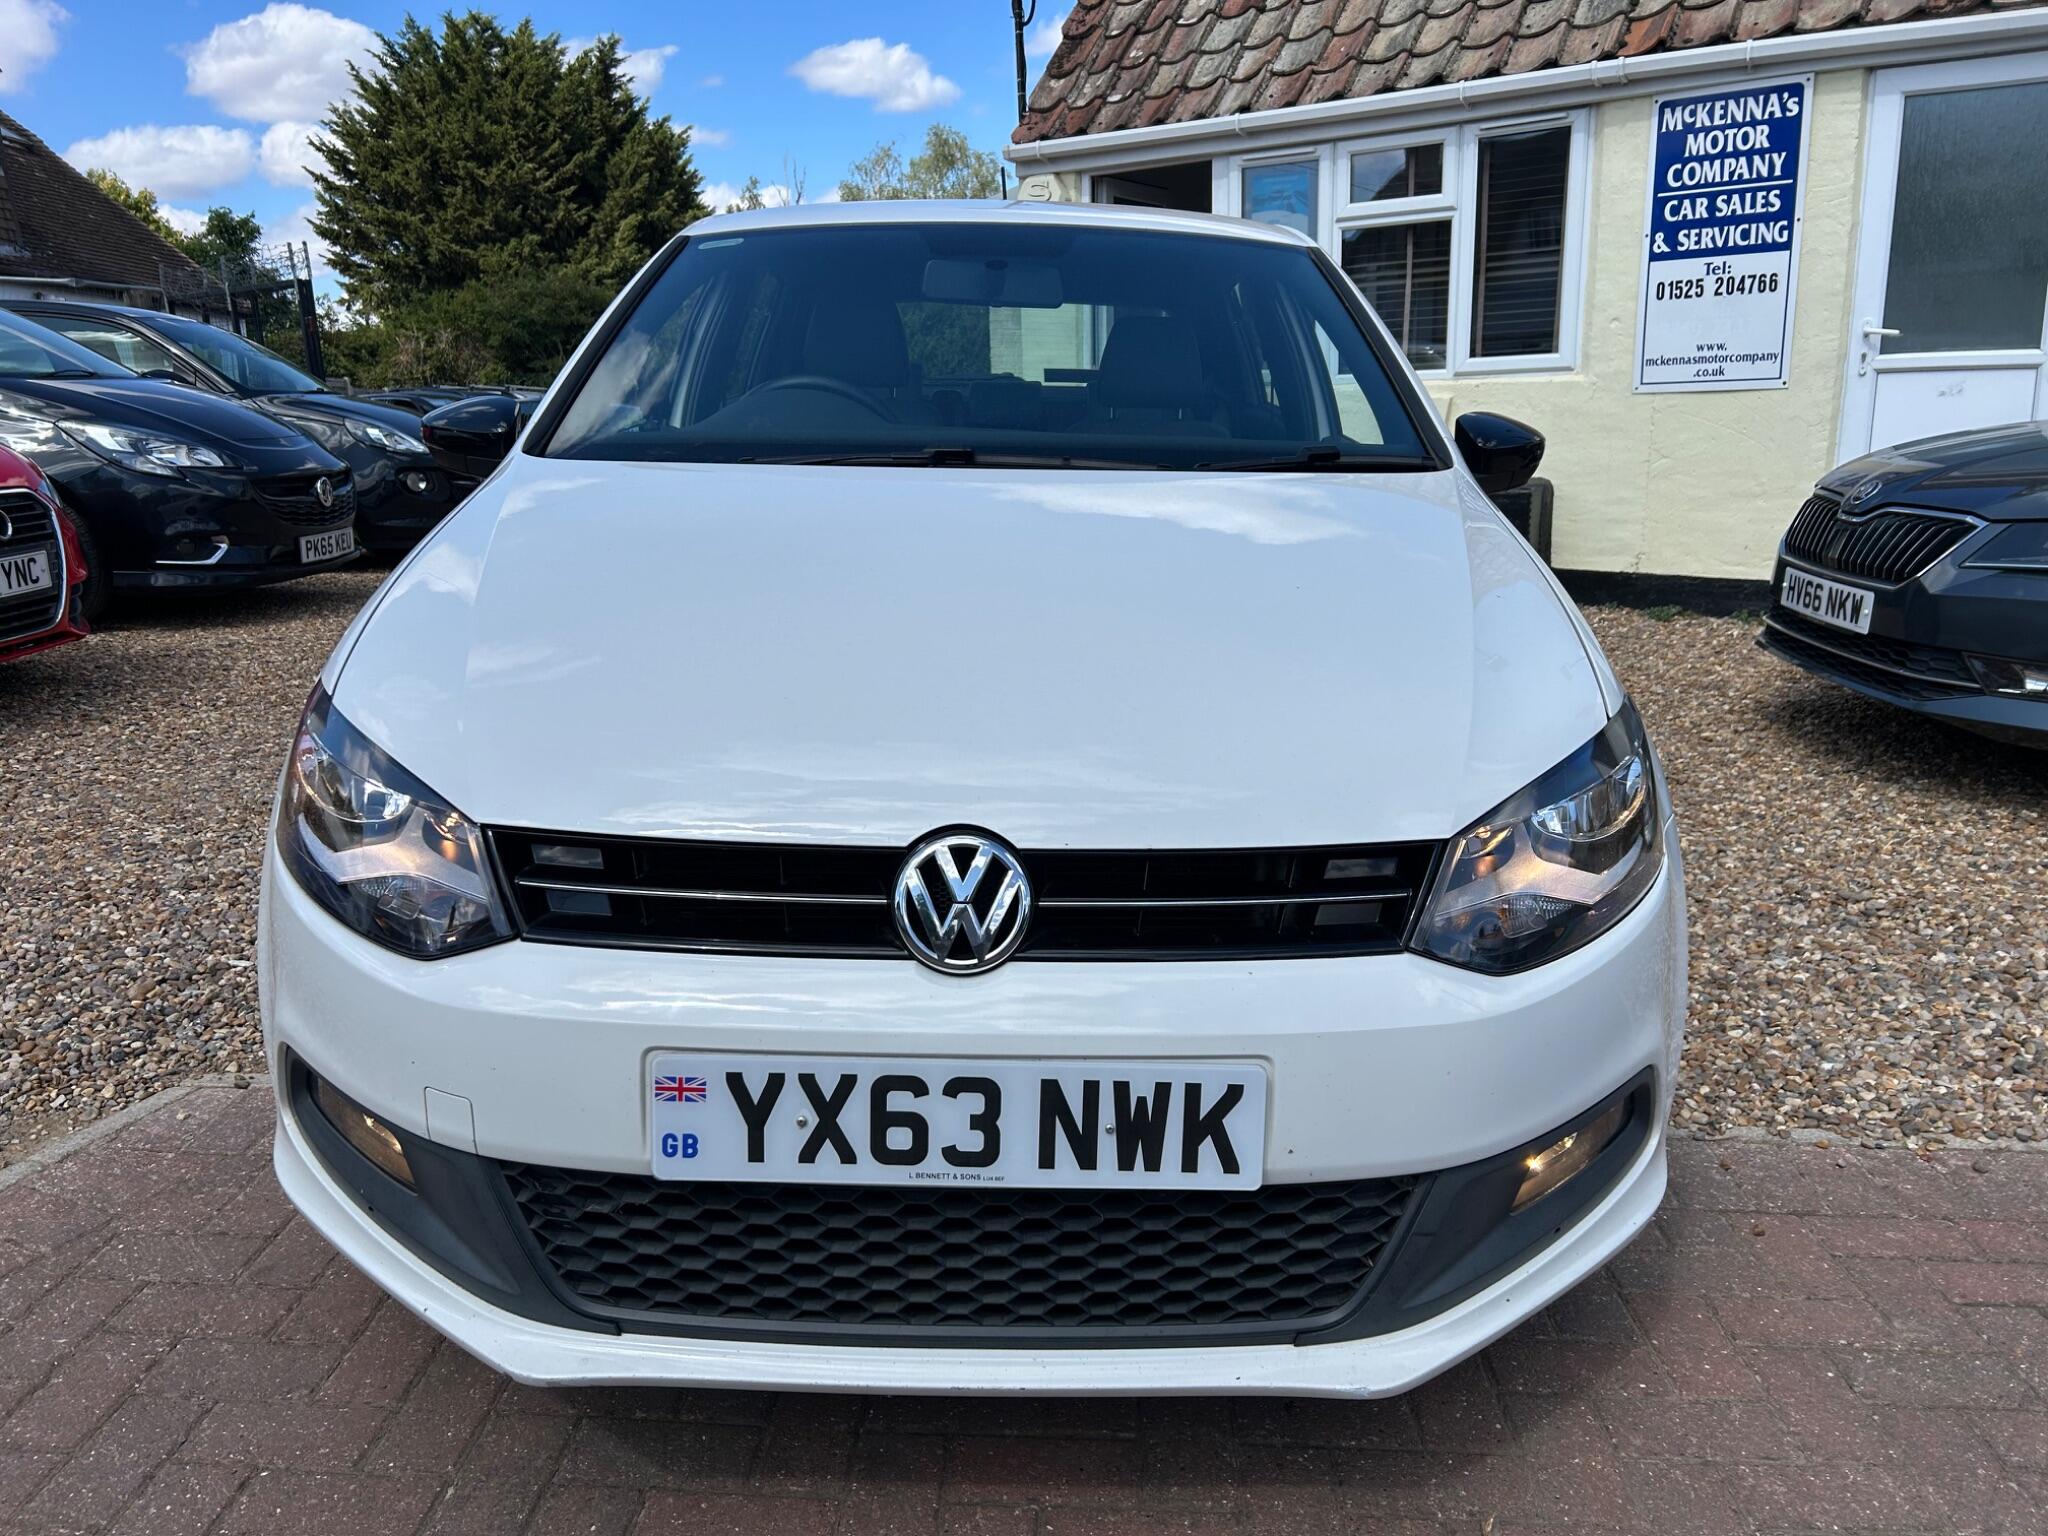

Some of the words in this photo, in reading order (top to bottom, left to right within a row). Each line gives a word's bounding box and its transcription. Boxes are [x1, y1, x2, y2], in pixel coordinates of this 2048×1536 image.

[1684, 124, 1770, 157] MOTOR
[1667, 152, 1787, 187] COMPANY
[1664, 197, 1709, 222] CAR
[1715, 190, 1781, 217] SALES
[1652, 232, 1671, 253] &
[1677, 220, 1789, 251] SERVICING
[1704, 261, 1732, 276] Tel:
[1656, 278, 1704, 301] 01525
[1714, 273, 1778, 296] 204766
[1645, 352, 1779, 366] mckennasmotorcompany
[1696, 342, 1727, 352] www.
[1693, 365, 1725, 377] .co.uk
[305, 536, 334, 560] PK65
[335, 531, 352, 553] KEU
[0, 557, 40, 590] YNC
[1786, 574, 1824, 612] HV66
[1825, 586, 1864, 624] NKW
[725, 1071, 1002, 1168] YX63
[1038, 1078, 1245, 1175] NWK
[662, 1133, 699, 1158] GB
[915, 1172, 950, 1180] BENNETT
[960, 1173, 981, 1181] SONS
